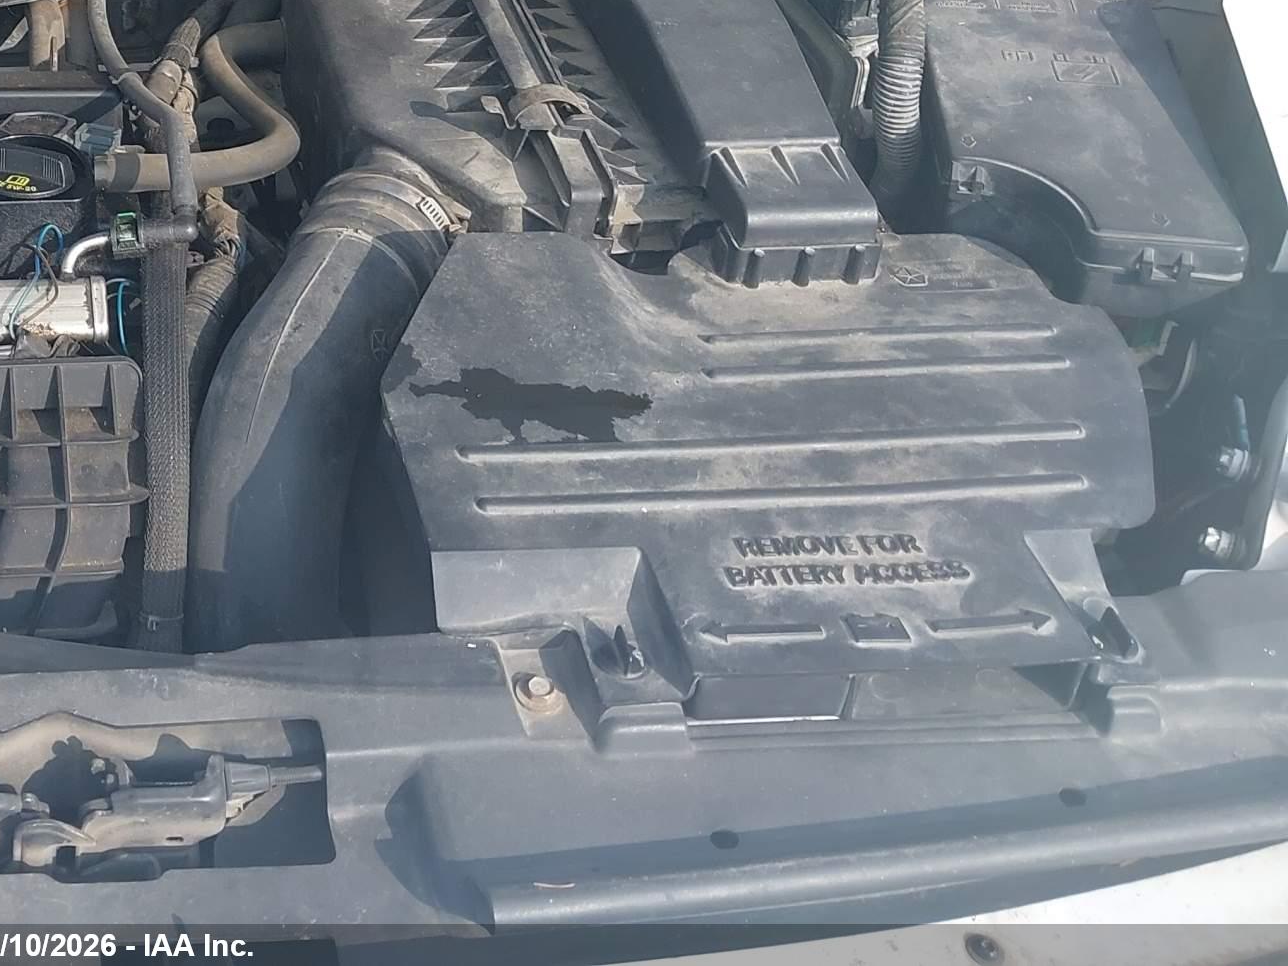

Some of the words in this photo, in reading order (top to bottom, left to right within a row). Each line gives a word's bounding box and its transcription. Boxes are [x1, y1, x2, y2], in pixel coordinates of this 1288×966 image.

[732, 534, 859, 558] REMOVE
[857, 533, 924, 555] FOR
[722, 564, 846, 587] BATTERY
[853, 559, 971, 585] ACCESS
